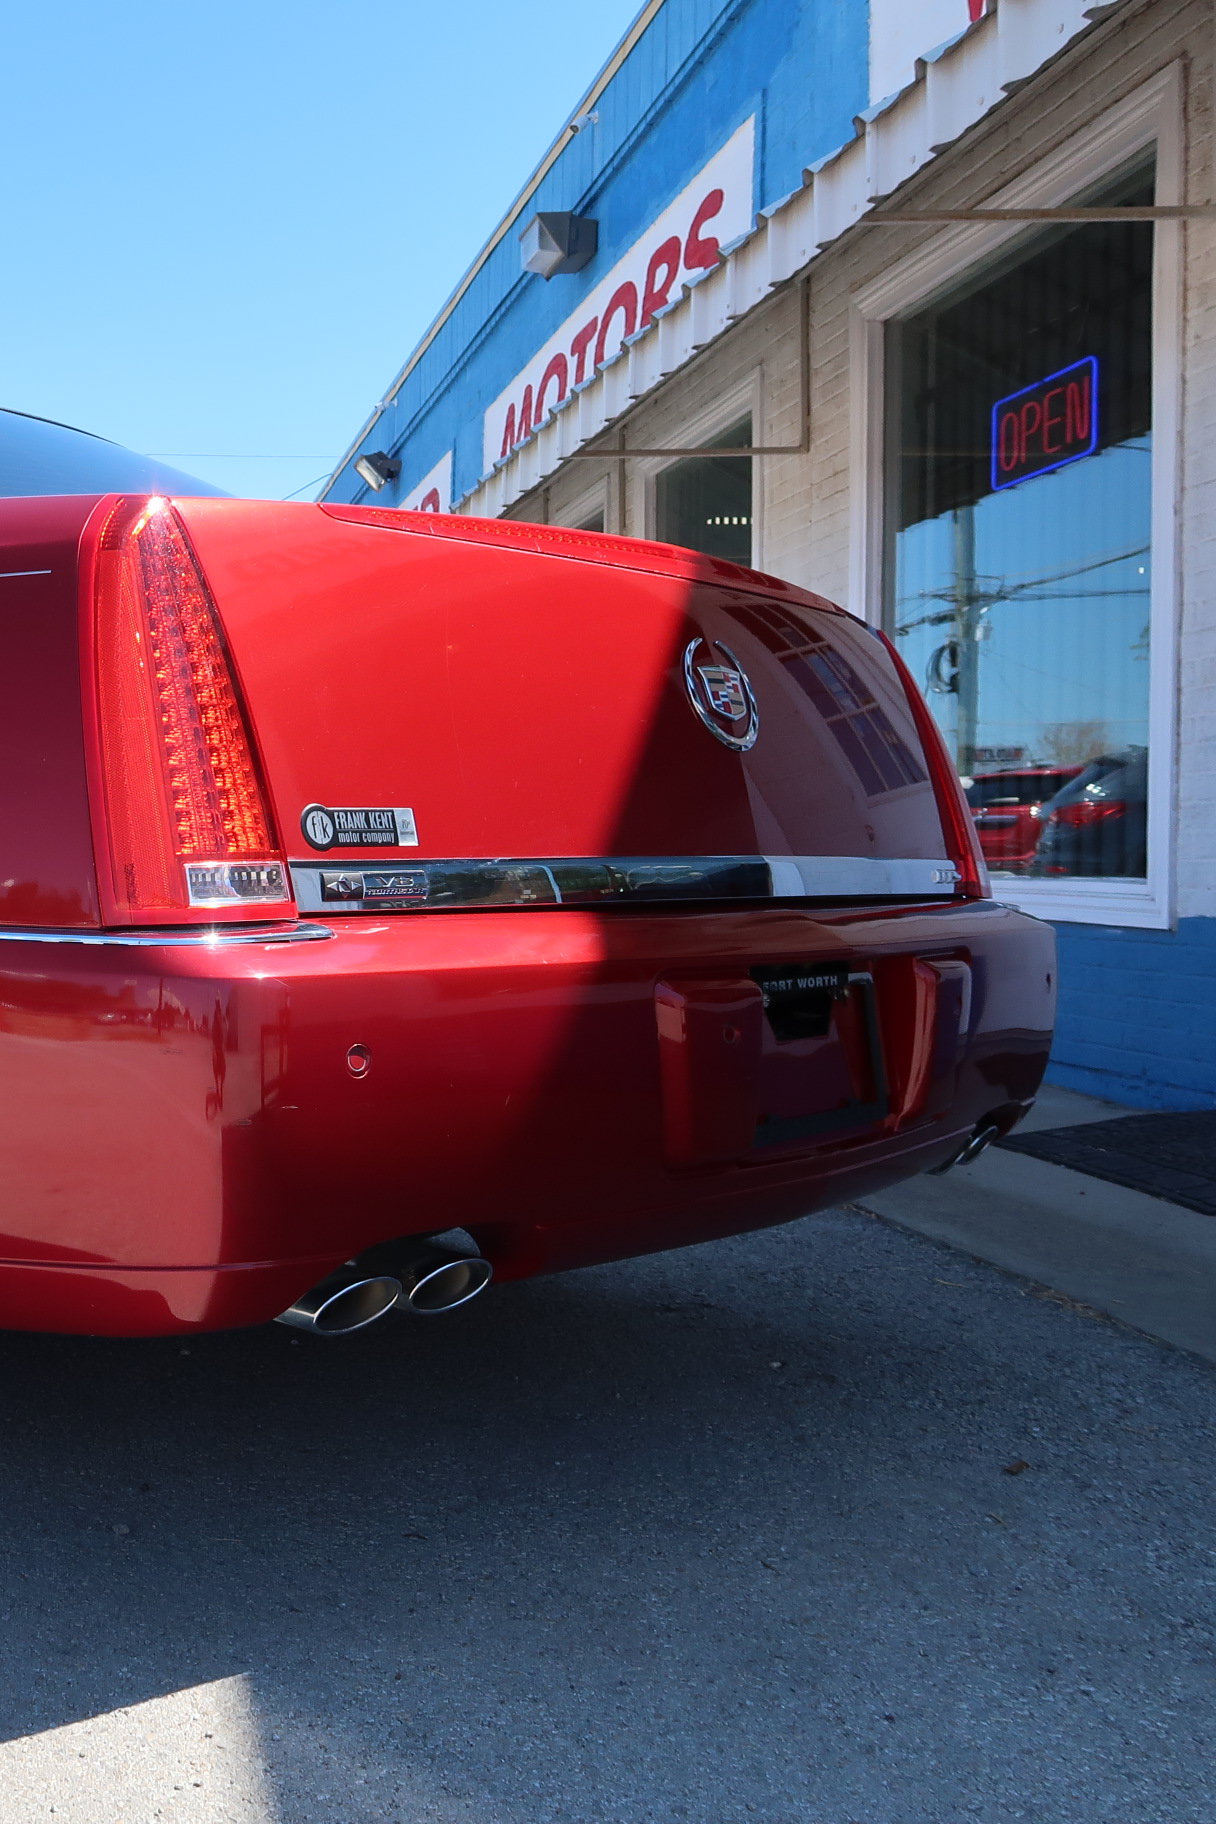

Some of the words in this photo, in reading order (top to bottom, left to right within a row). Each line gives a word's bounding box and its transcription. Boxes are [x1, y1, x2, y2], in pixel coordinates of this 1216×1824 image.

[500, 188, 725, 458] MOTORS
[999, 375, 1091, 471] OPEN
[333, 811, 367, 829] FRANK
[367, 811, 394, 829] KENT
[338, 831, 360, 843] motor
[362, 831, 395, 843] company
[762, 979, 793, 991] FORT
[797, 975, 838, 989] WORTH
